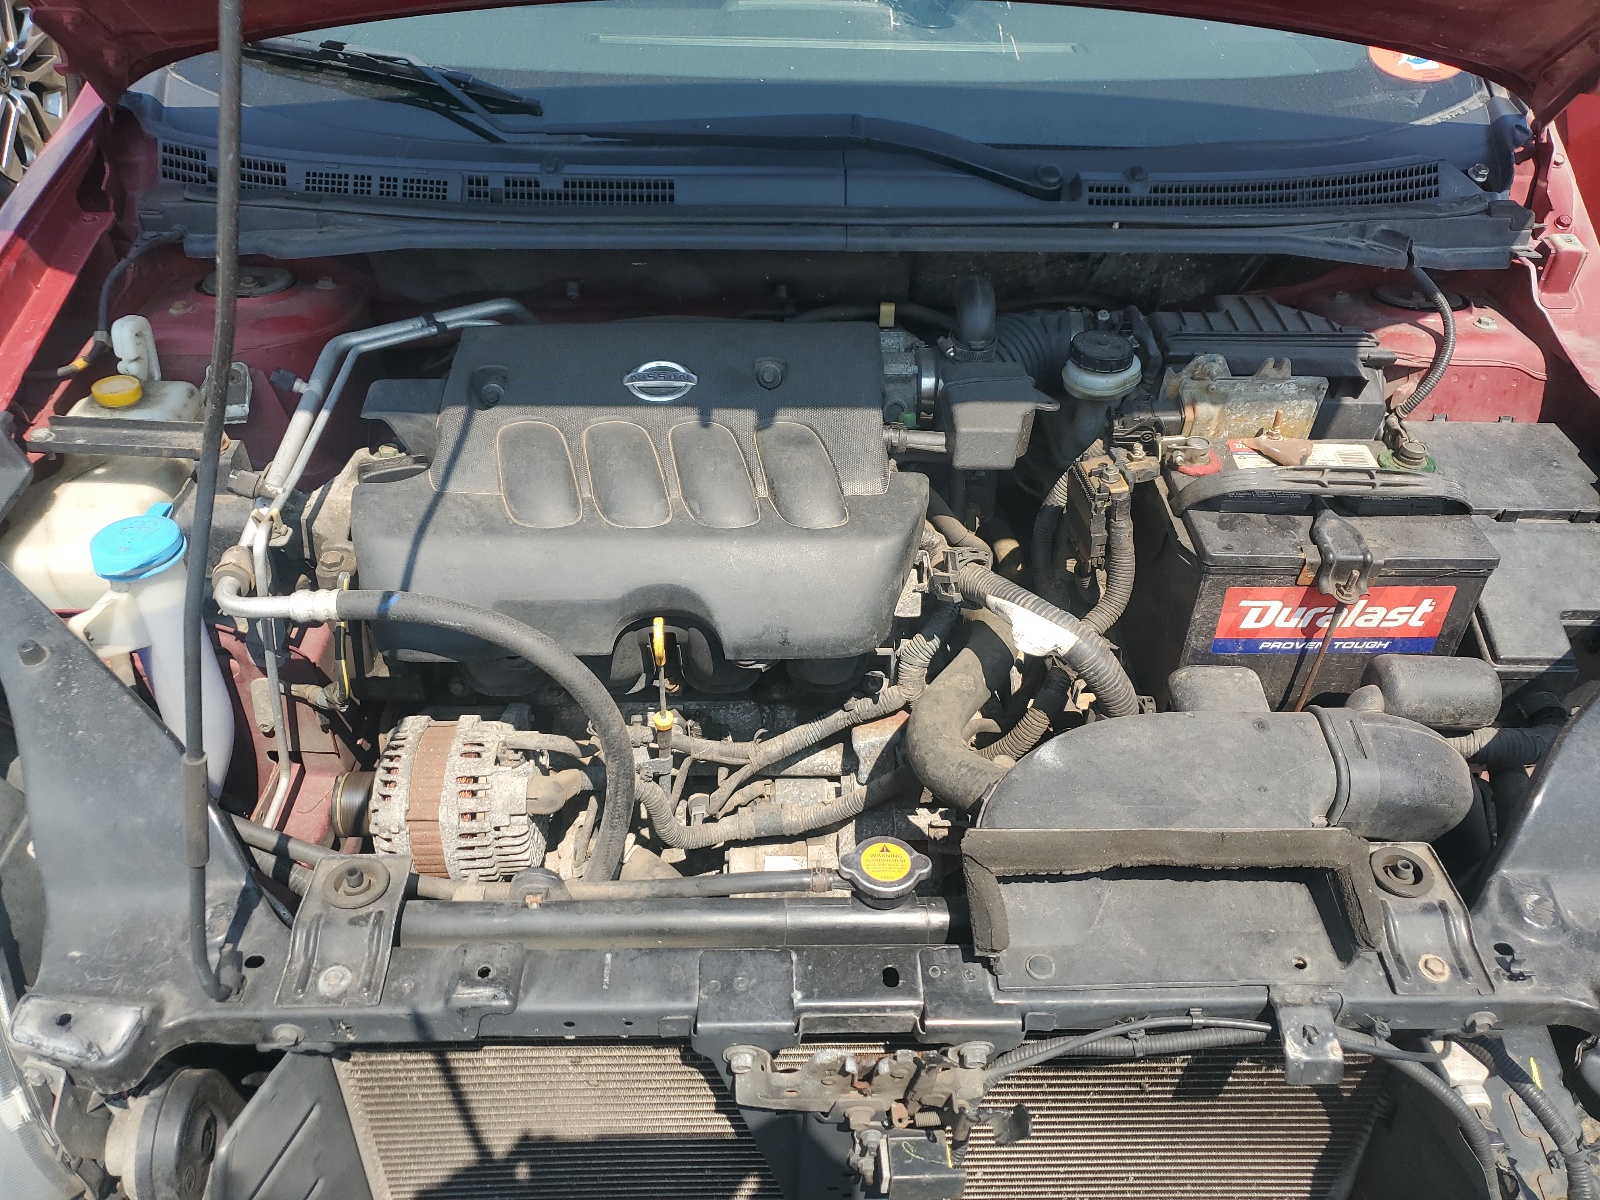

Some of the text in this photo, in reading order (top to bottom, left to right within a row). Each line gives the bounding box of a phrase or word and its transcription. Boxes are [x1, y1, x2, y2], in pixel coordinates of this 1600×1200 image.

[631, 372, 690, 380] NISSAN
[1239, 598, 1437, 628] Duralast
[1334, 641, 1391, 649] TOUGH
